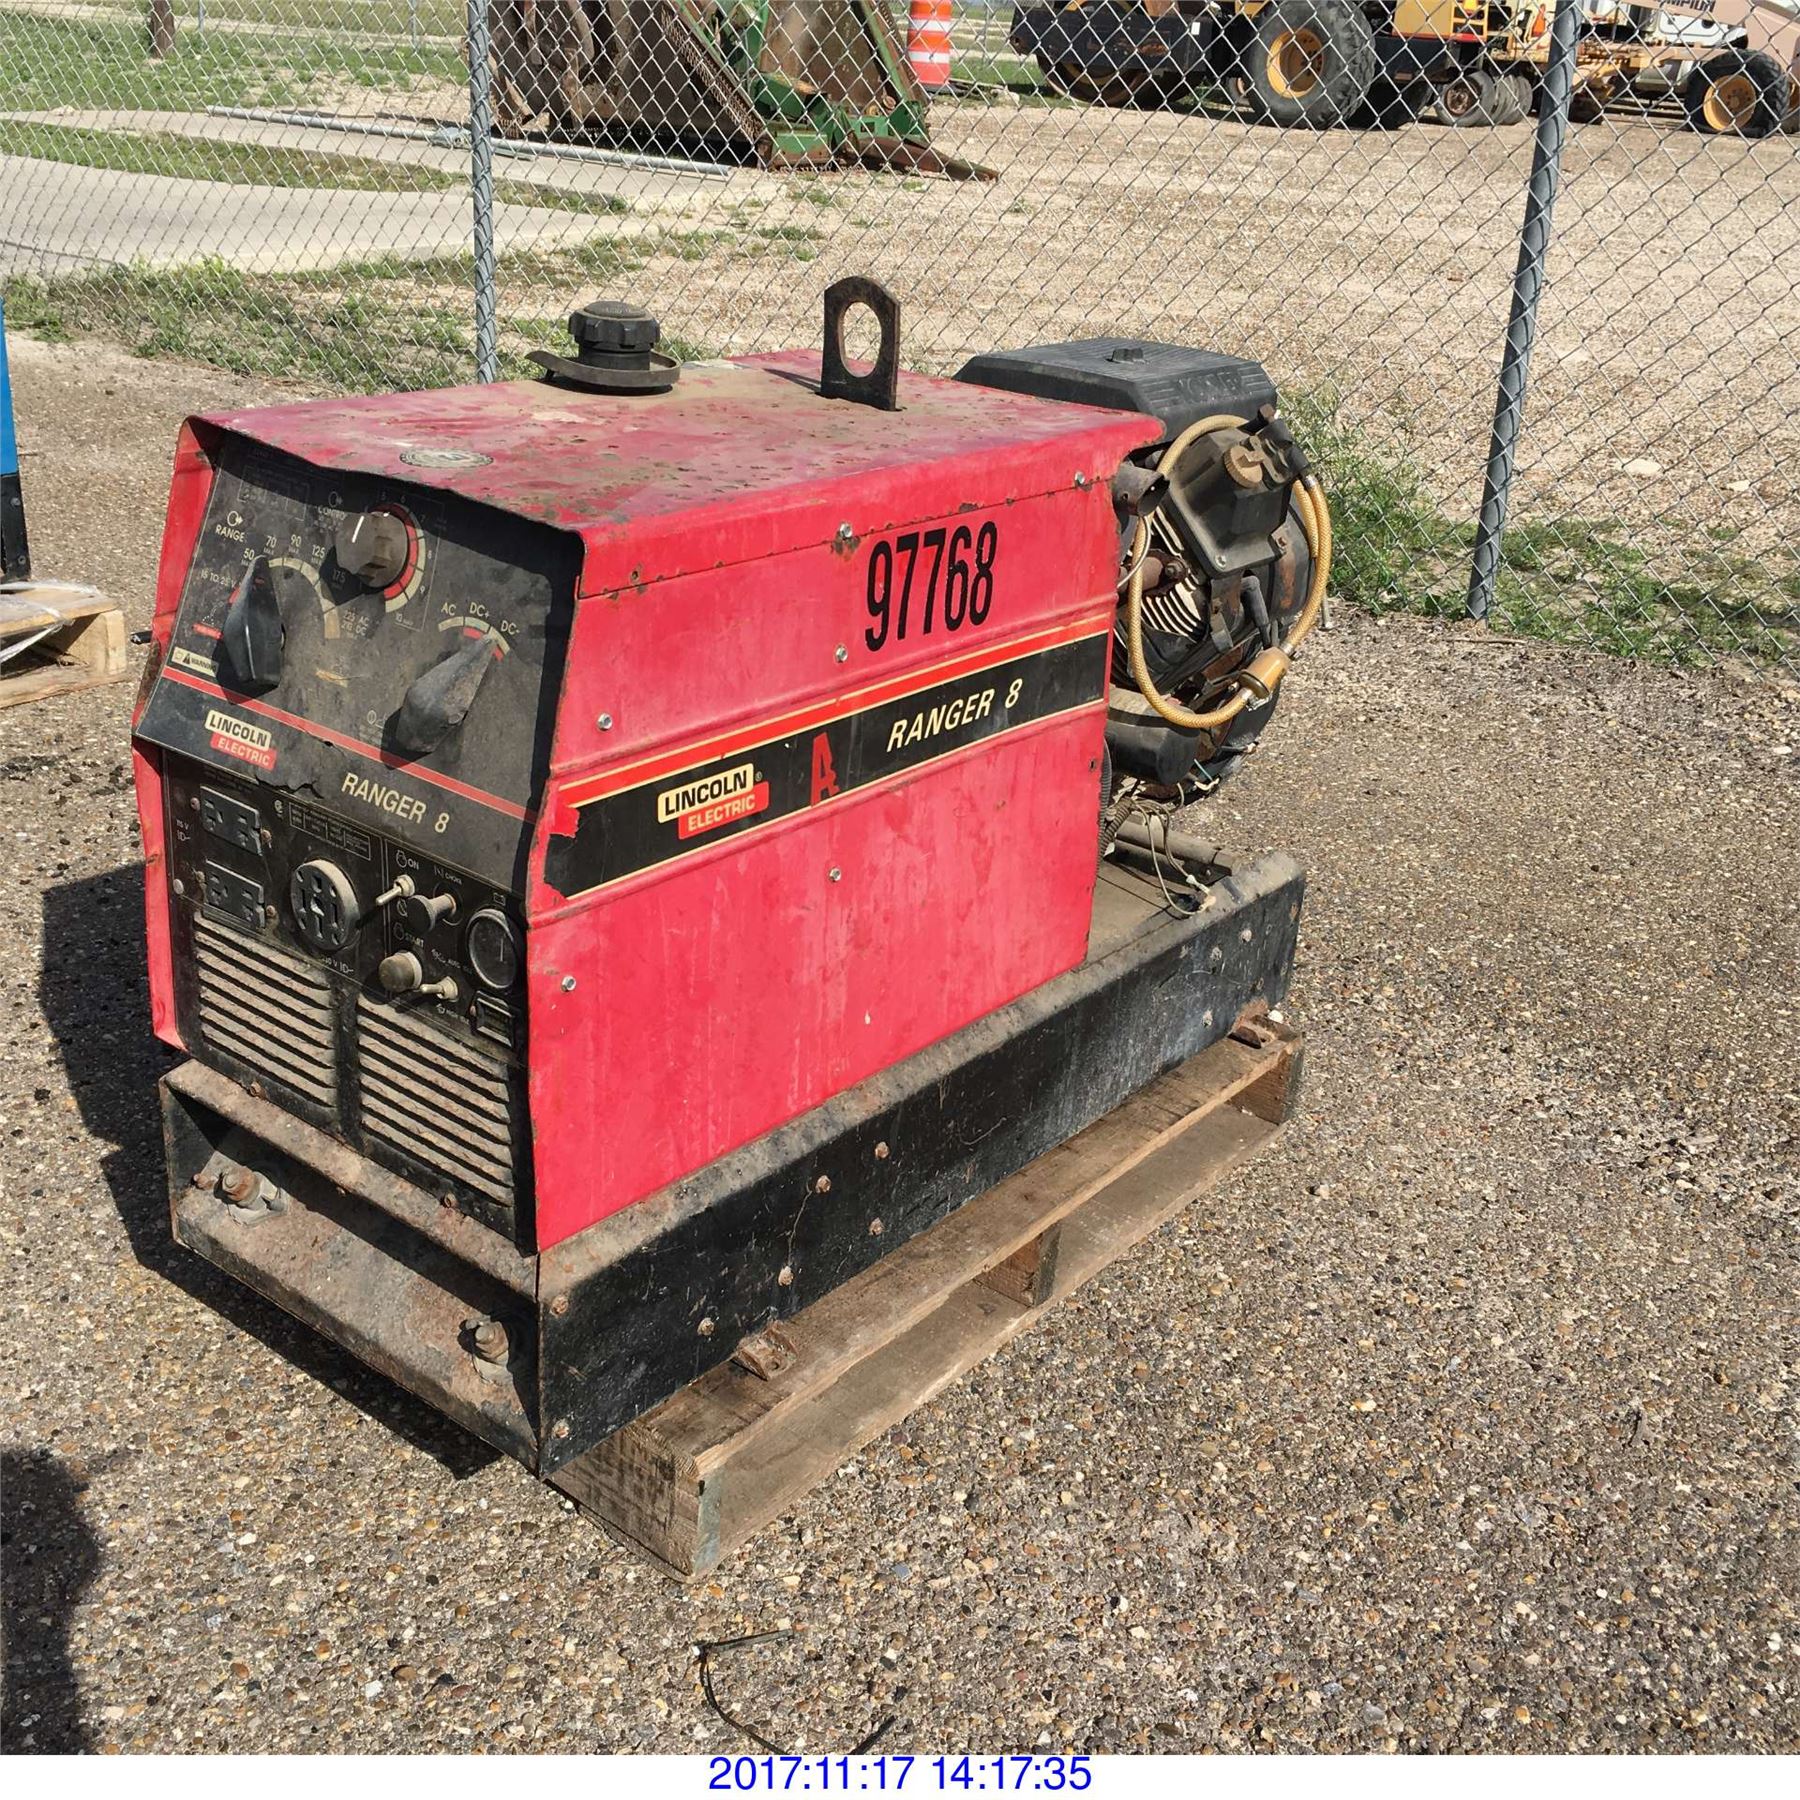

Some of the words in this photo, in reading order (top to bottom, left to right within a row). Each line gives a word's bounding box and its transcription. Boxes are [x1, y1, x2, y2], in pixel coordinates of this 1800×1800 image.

[215, 524, 246, 542] RANGE
[265, 535, 278, 548] 70
[290, 534, 302, 547] 90
[243, 547, 255, 560] 50
[312, 544, 325, 558] 125
[865, 521, 998, 652] 97768
[441, 602, 457, 616] AC
[469, 602, 489, 619] DC+
[886, 688, 995, 752] RANGER
[1004, 678, 1023, 709] 8
[209, 714, 268, 747] LINCOLN
[217, 738, 270, 766] ELECTRIC
[664, 770, 748, 816] LINCOLN
[341, 772, 427, 824] RANGER
[434, 812, 450, 833] 8
[687, 794, 756, 832] ELECTRIC
[407, 858, 419, 870] ON
